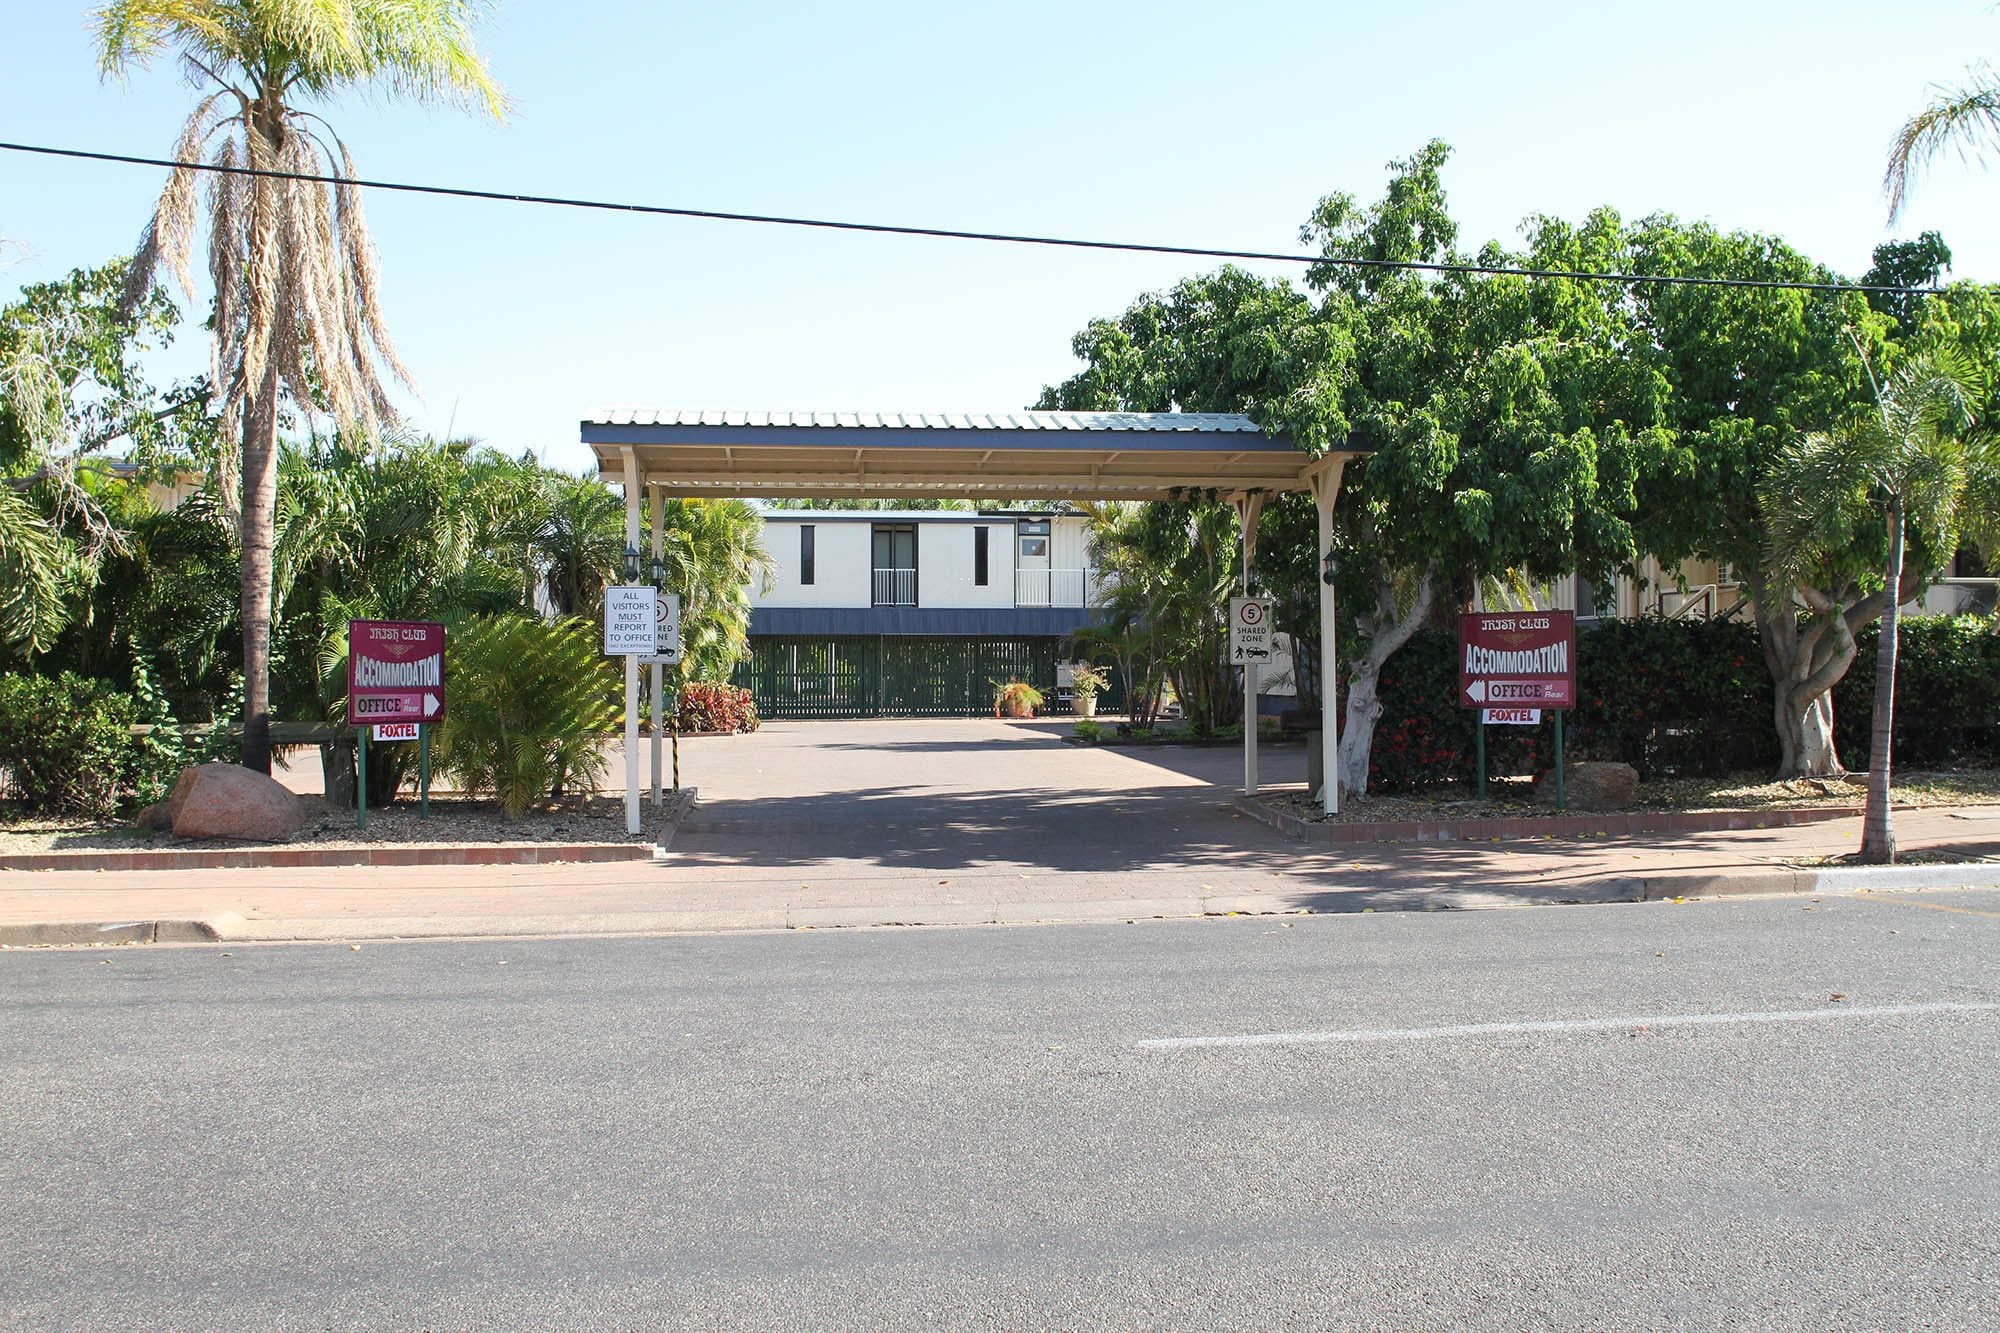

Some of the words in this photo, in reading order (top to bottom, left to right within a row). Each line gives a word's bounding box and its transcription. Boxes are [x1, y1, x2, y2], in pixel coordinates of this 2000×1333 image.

[623, 592, 639, 600] ALL
[612, 602, 650, 610] VISITORS
[1247, 608, 1255, 619] 5
[614, 623, 647, 631] REPORT
[1481, 619, 1515, 632] IRISH
[1519, 618, 1550, 629] CLUB
[369, 628, 399, 642] IRISH
[402, 629, 427, 640] CLUB
[609, 633, 621, 641] TO
[623, 633, 653, 641] OFFICE
[1465, 640, 1568, 674] ACCOMMODATION
[355, 652, 440, 687] ACCOMMODATION
[1491, 684, 1542, 698] OFFICE
[358, 698, 401, 713] OFFICE
[403, 704, 419, 712] Rear
[1488, 709, 1534, 721] FOXTEL
[379, 724, 417, 737] FOXTEL
